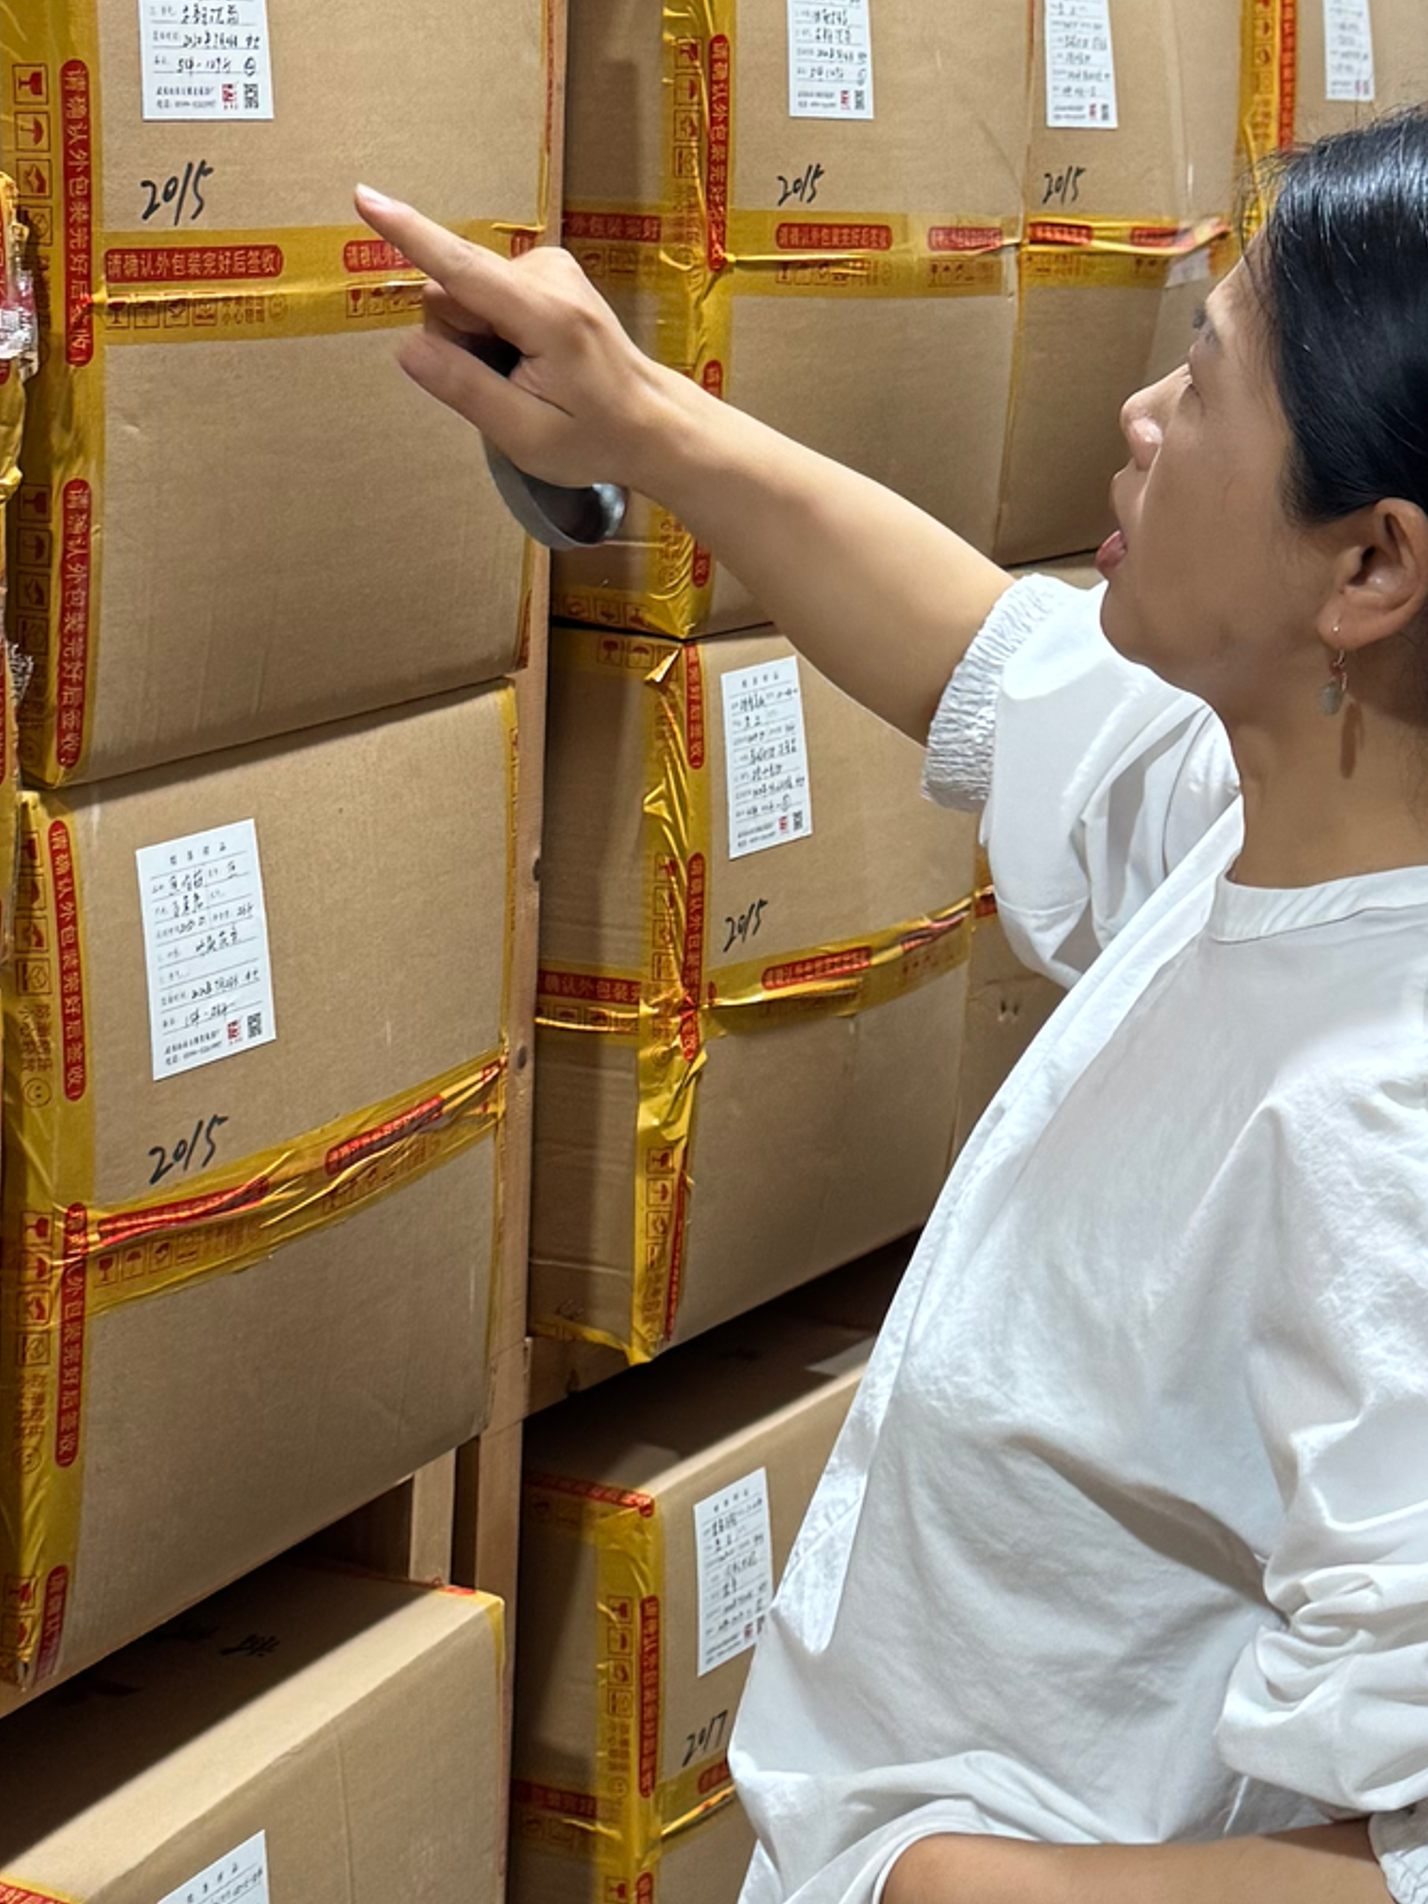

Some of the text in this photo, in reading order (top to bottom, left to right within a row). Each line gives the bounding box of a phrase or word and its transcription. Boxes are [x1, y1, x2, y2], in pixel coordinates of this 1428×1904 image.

[139, 158, 214, 226] 2015
[777, 163, 825, 207] 2015
[1043, 165, 1086, 202] 2015
[107, 242, 283, 285] 请确认外包装完好后签收!
[724, 898, 769, 954] 2015
[149, 1113, 228, 1185] 2015
